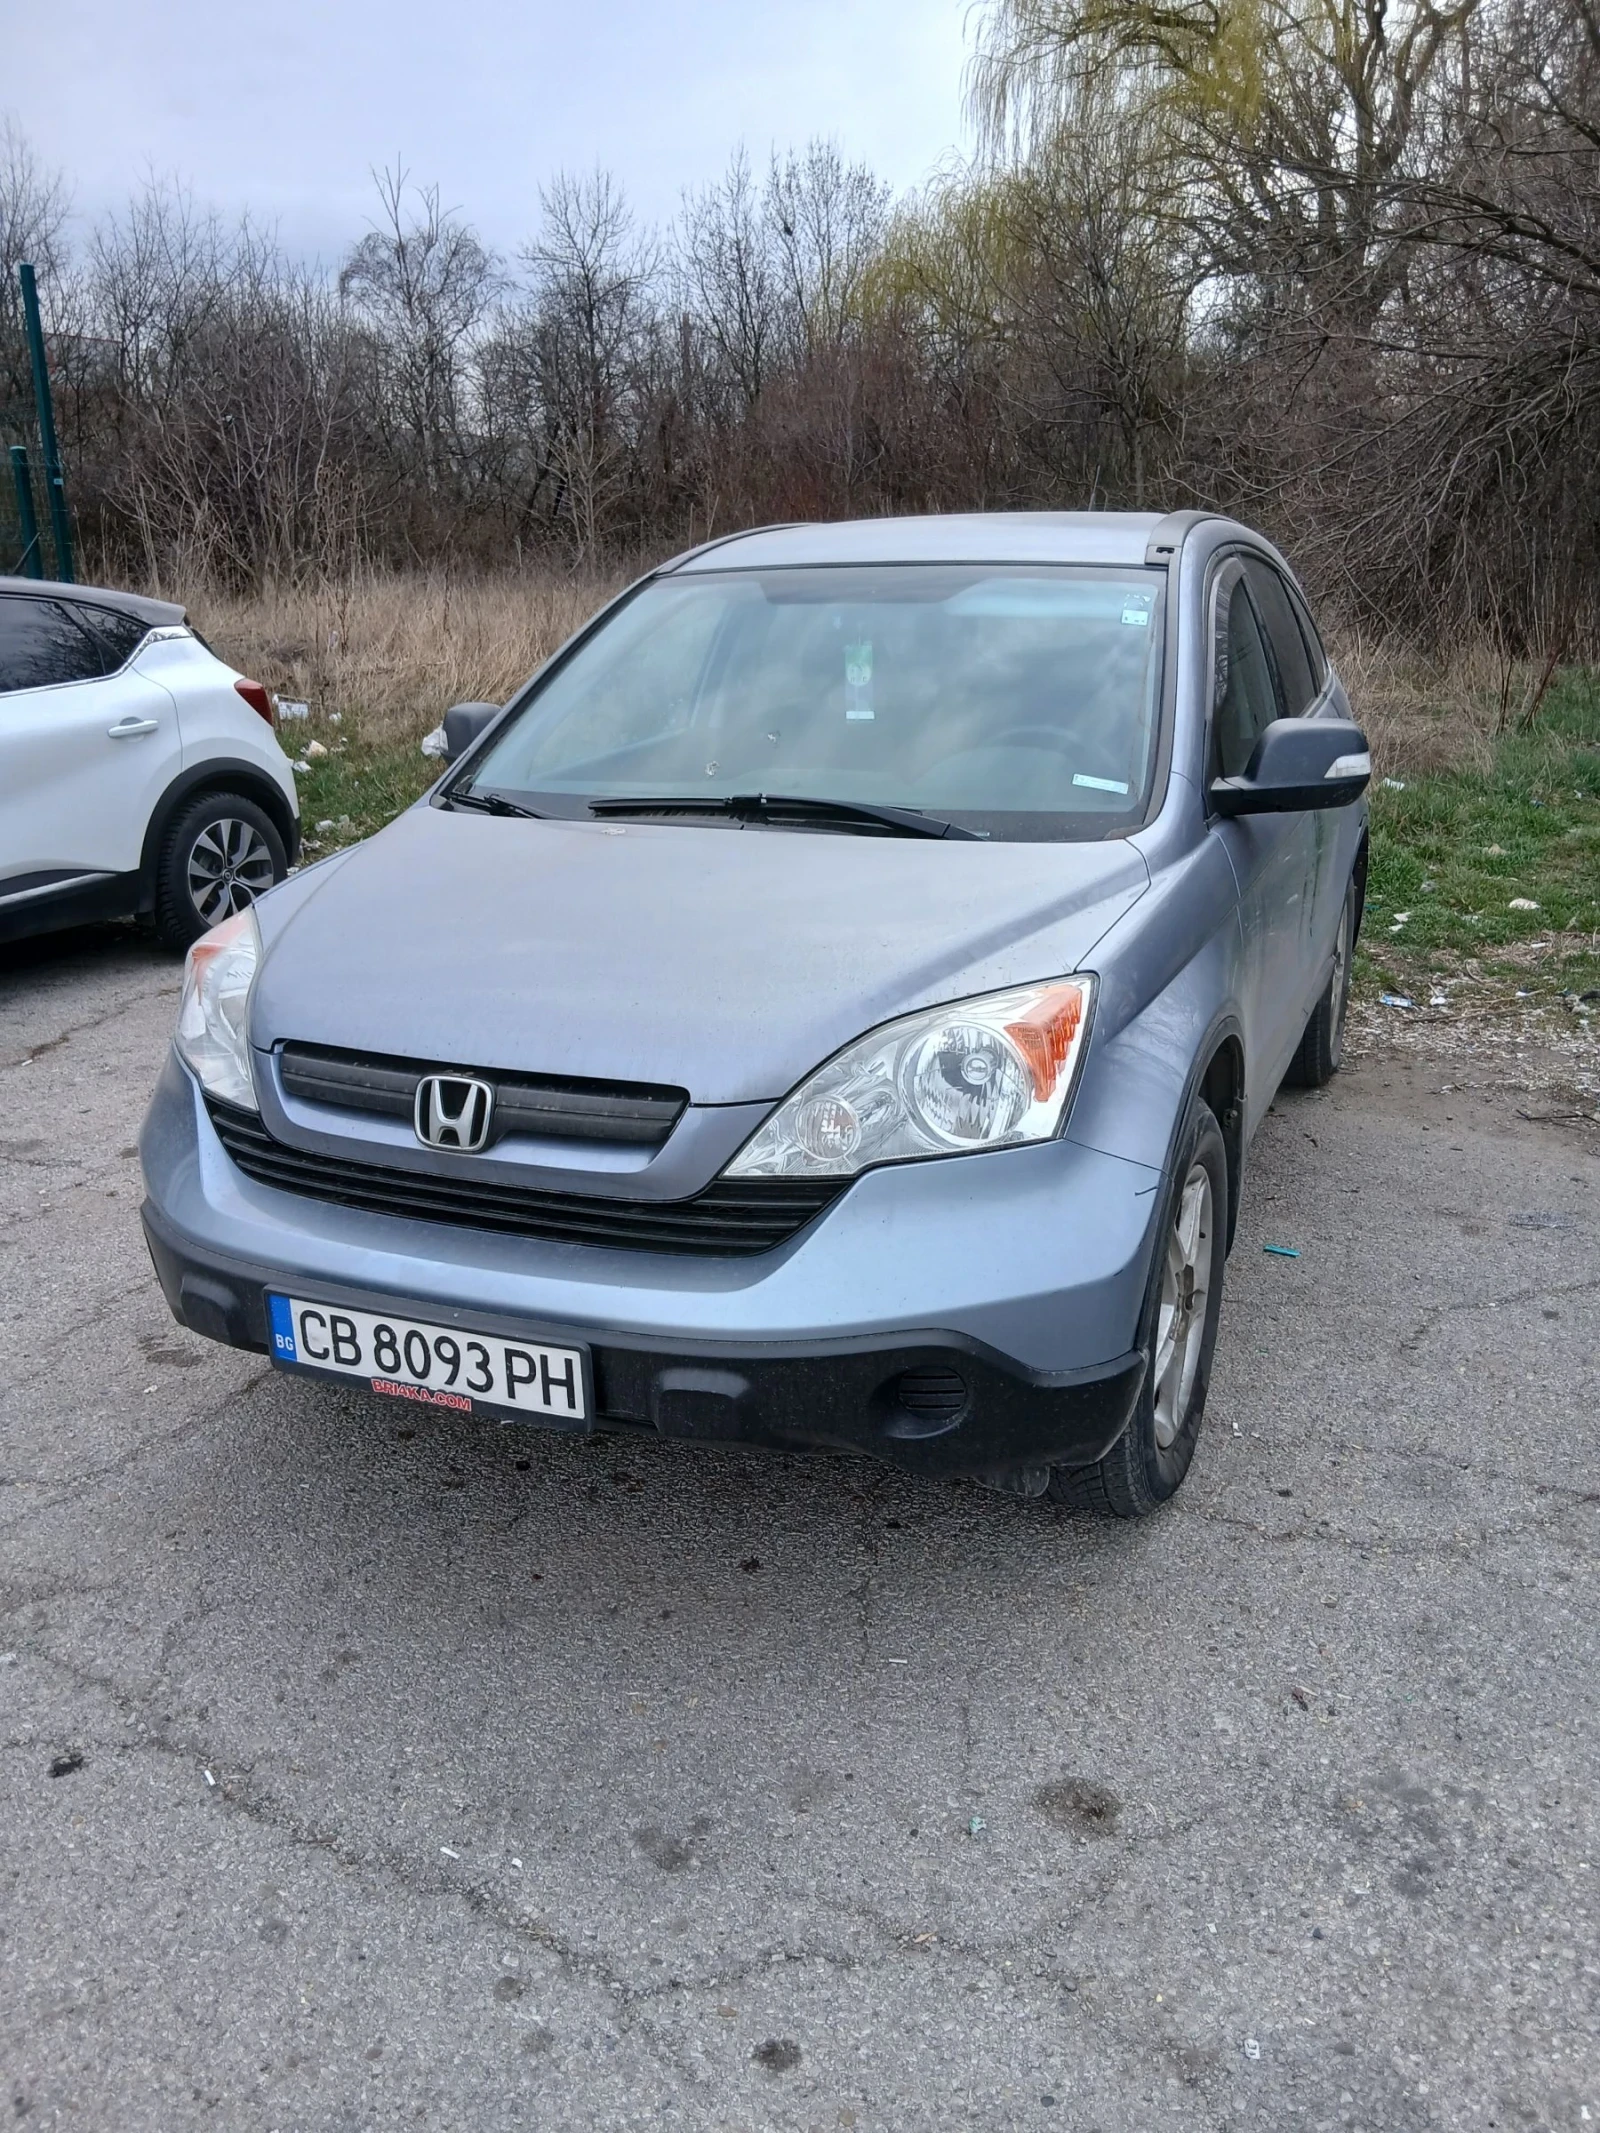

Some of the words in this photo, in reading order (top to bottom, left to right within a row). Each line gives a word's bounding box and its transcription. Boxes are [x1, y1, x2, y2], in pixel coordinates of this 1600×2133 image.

[275, 1333, 294, 1351] BG
[300, 1309, 362, 1366] CB
[373, 1323, 494, 1393] 8093
[504, 1347, 576, 1410] PH
